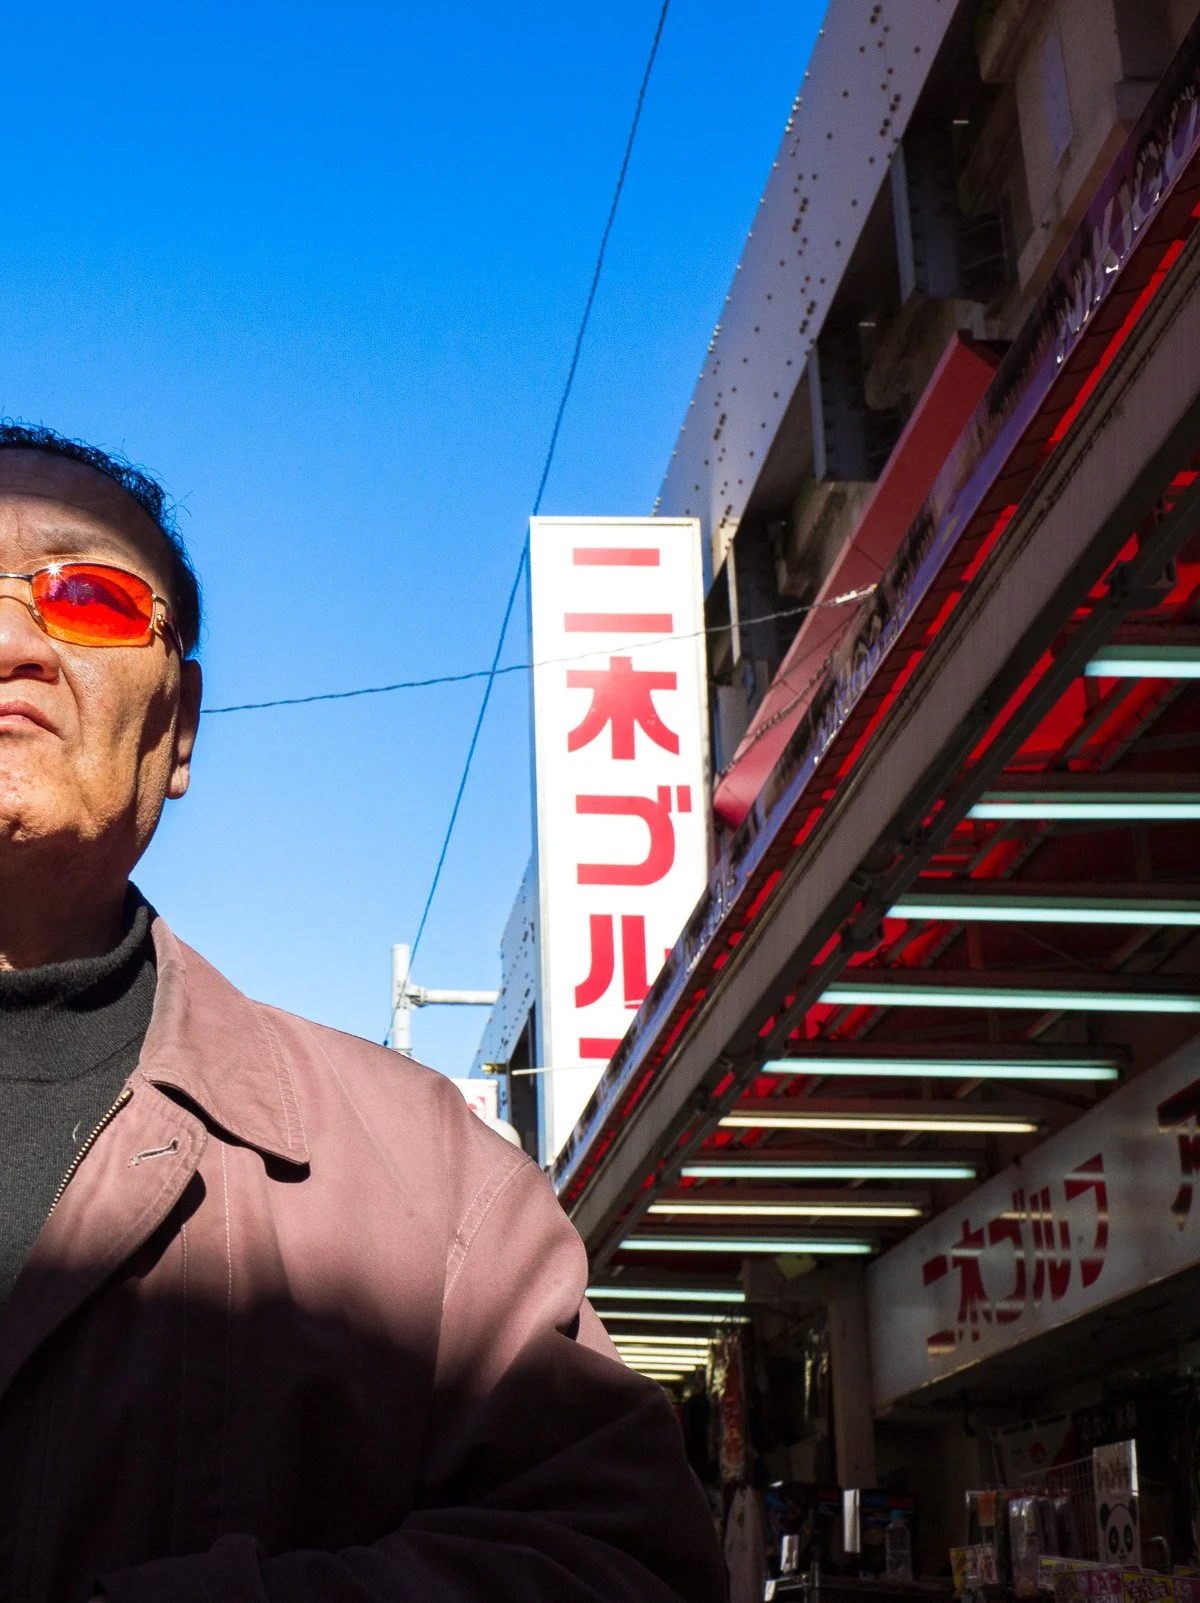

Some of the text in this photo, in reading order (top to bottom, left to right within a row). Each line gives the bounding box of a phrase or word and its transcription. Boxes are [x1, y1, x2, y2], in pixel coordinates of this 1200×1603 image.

[922, 1153, 1109, 1355] 二木ゴルフ
